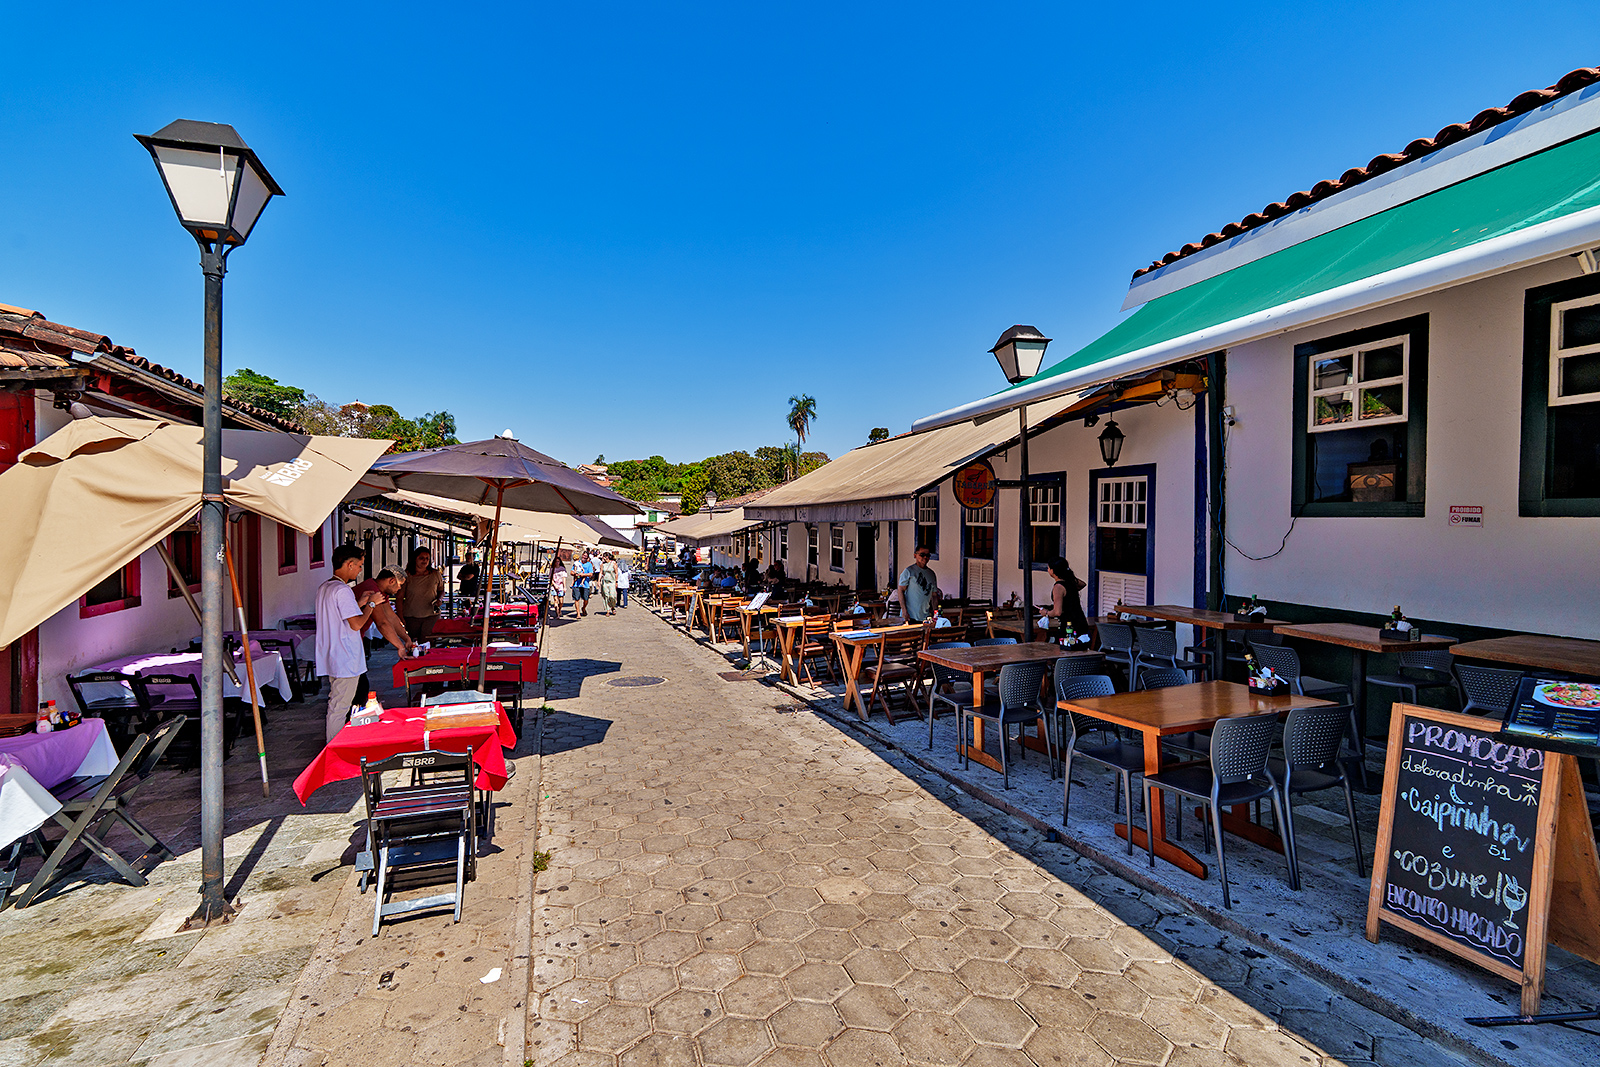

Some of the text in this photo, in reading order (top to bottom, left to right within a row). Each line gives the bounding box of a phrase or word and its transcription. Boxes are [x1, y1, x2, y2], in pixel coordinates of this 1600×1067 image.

[277, 457, 313, 480] BRB
[360, 717, 371, 725] 10
[413, 757, 436, 766] BRB
[1401, 754, 1523, 802] dobradinha
[1408, 786, 1531, 853] Caipirinha
[1442, 845, 1455, 858] e
[1488, 844, 1511, 861] 51
[1387, 883, 1449, 924] ENCONTRO
